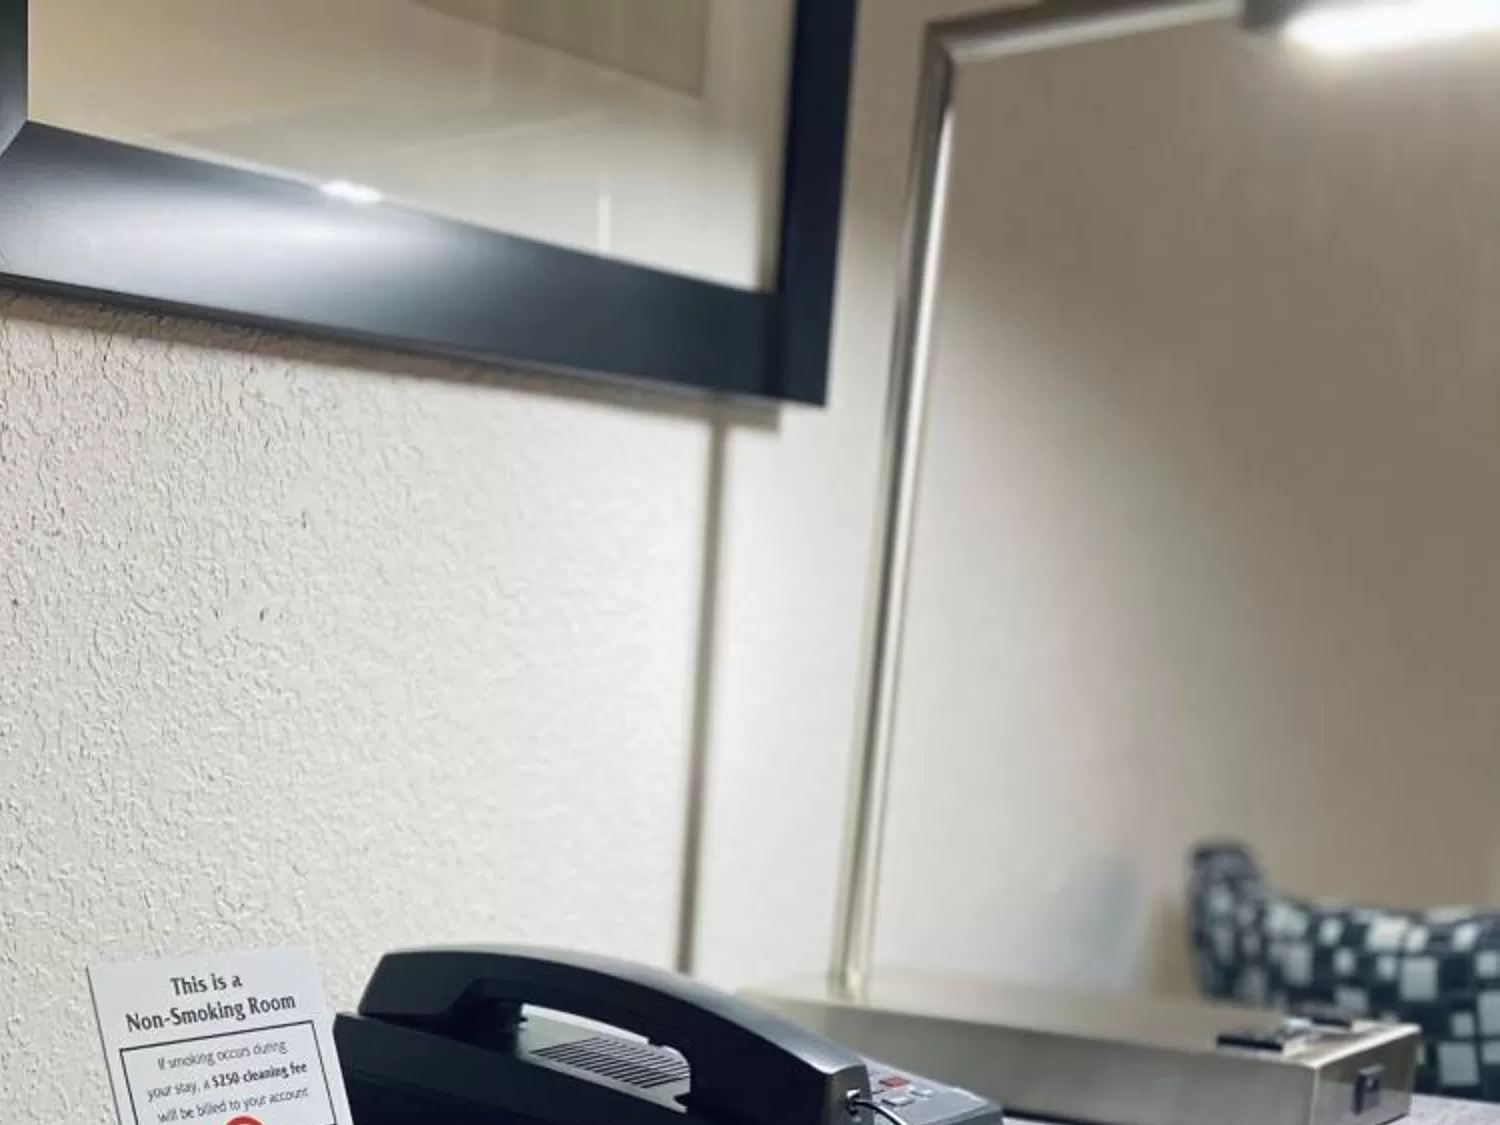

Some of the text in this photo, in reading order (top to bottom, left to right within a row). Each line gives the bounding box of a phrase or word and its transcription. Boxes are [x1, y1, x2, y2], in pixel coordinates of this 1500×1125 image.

[170, 973, 243, 996] This is a
[125, 995, 296, 1032] Non-Smoking Room
[168, 1052, 216, 1069] smoking
[216, 1046, 251, 1061] occurs
[253, 1041, 289, 1055] during
[147, 1085, 171, 1102] your
[211, 1071, 241, 1089] $250
[243, 1065, 289, 1084] cleaning
[289, 1062, 308, 1075] fee
[157, 1108, 178, 1123] will
[179, 1106, 195, 1119] be
[196, 1099, 227, 1117] billed
[230, 1098, 241, 1111] to
[243, 1096, 267, 1112] your
